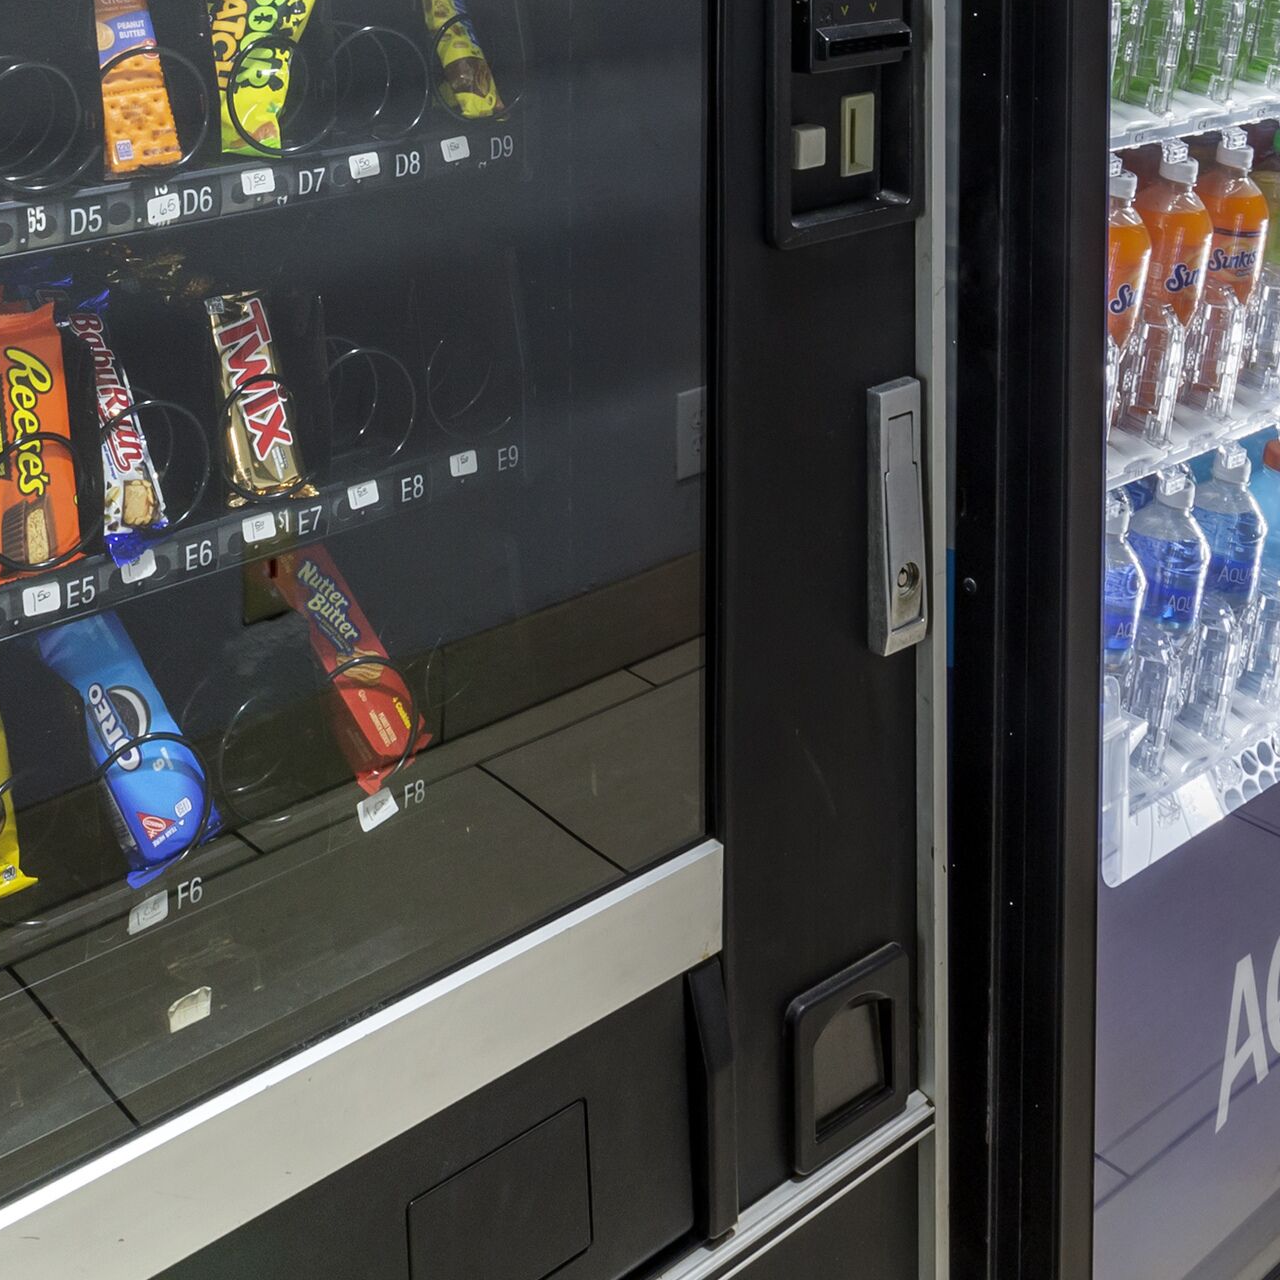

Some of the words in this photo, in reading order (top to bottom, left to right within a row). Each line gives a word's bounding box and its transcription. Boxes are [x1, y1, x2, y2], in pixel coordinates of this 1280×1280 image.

[116, 20, 145, 30] PEANUT
[119, 28, 147, 39] BUTTER
[491, 135, 513, 160] D9
[396, 151, 421, 178] D8
[298, 168, 326, 195] D7
[183, 187, 213, 213] D6
[69, 205, 102, 235] D5
[218, 297, 294, 462] TWIX
[497, 445, 519, 472] E9
[401, 474, 424, 504] E8
[298, 505, 323, 536] E7
[185, 539, 213, 571] E6
[66, 576, 97, 610] E5
[297, 560, 349, 610] Nutter
[307, 592, 359, 640] Butter
[88, 683, 142, 772] OREO
[404, 779, 426, 809] F8
[176, 876, 204, 909] F6
